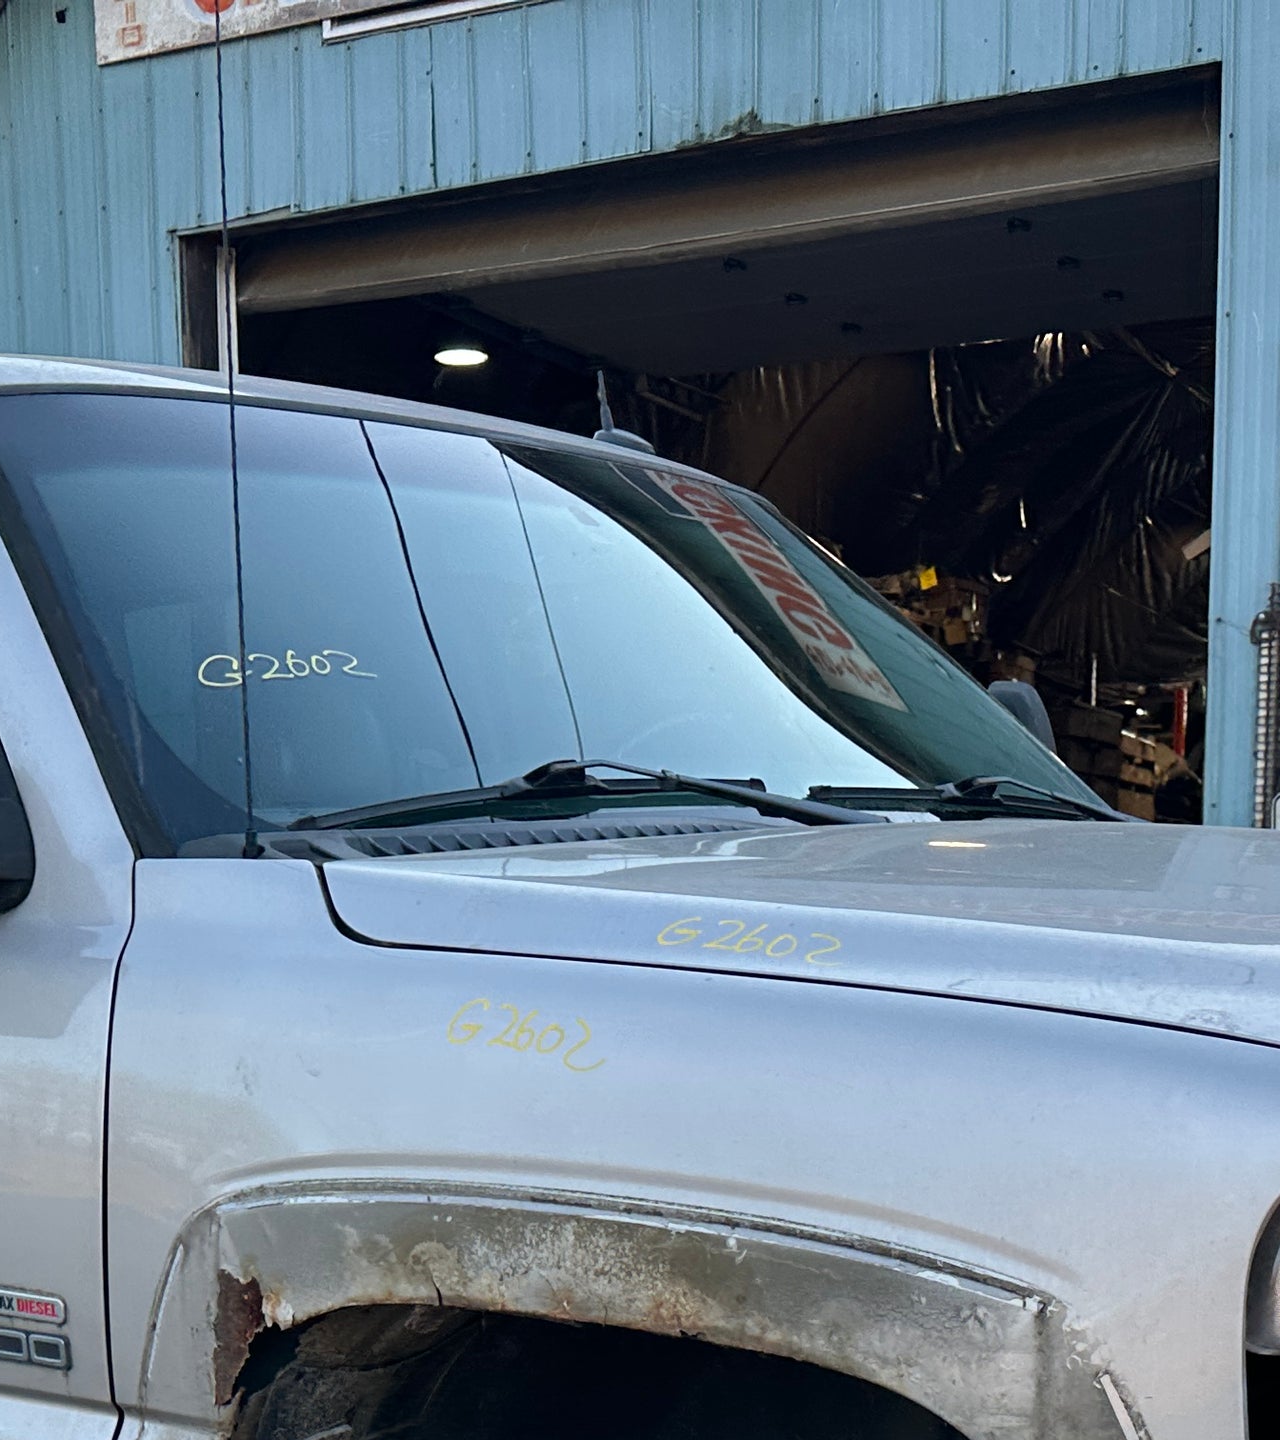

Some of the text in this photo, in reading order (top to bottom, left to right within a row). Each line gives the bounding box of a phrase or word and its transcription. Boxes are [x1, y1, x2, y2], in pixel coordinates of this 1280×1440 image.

[198, 649, 377, 688] G2602
[656, 916, 842, 968] G2602
[447, 998, 605, 1071] G2602
[16, 1298, 59, 1318] DIESEL
